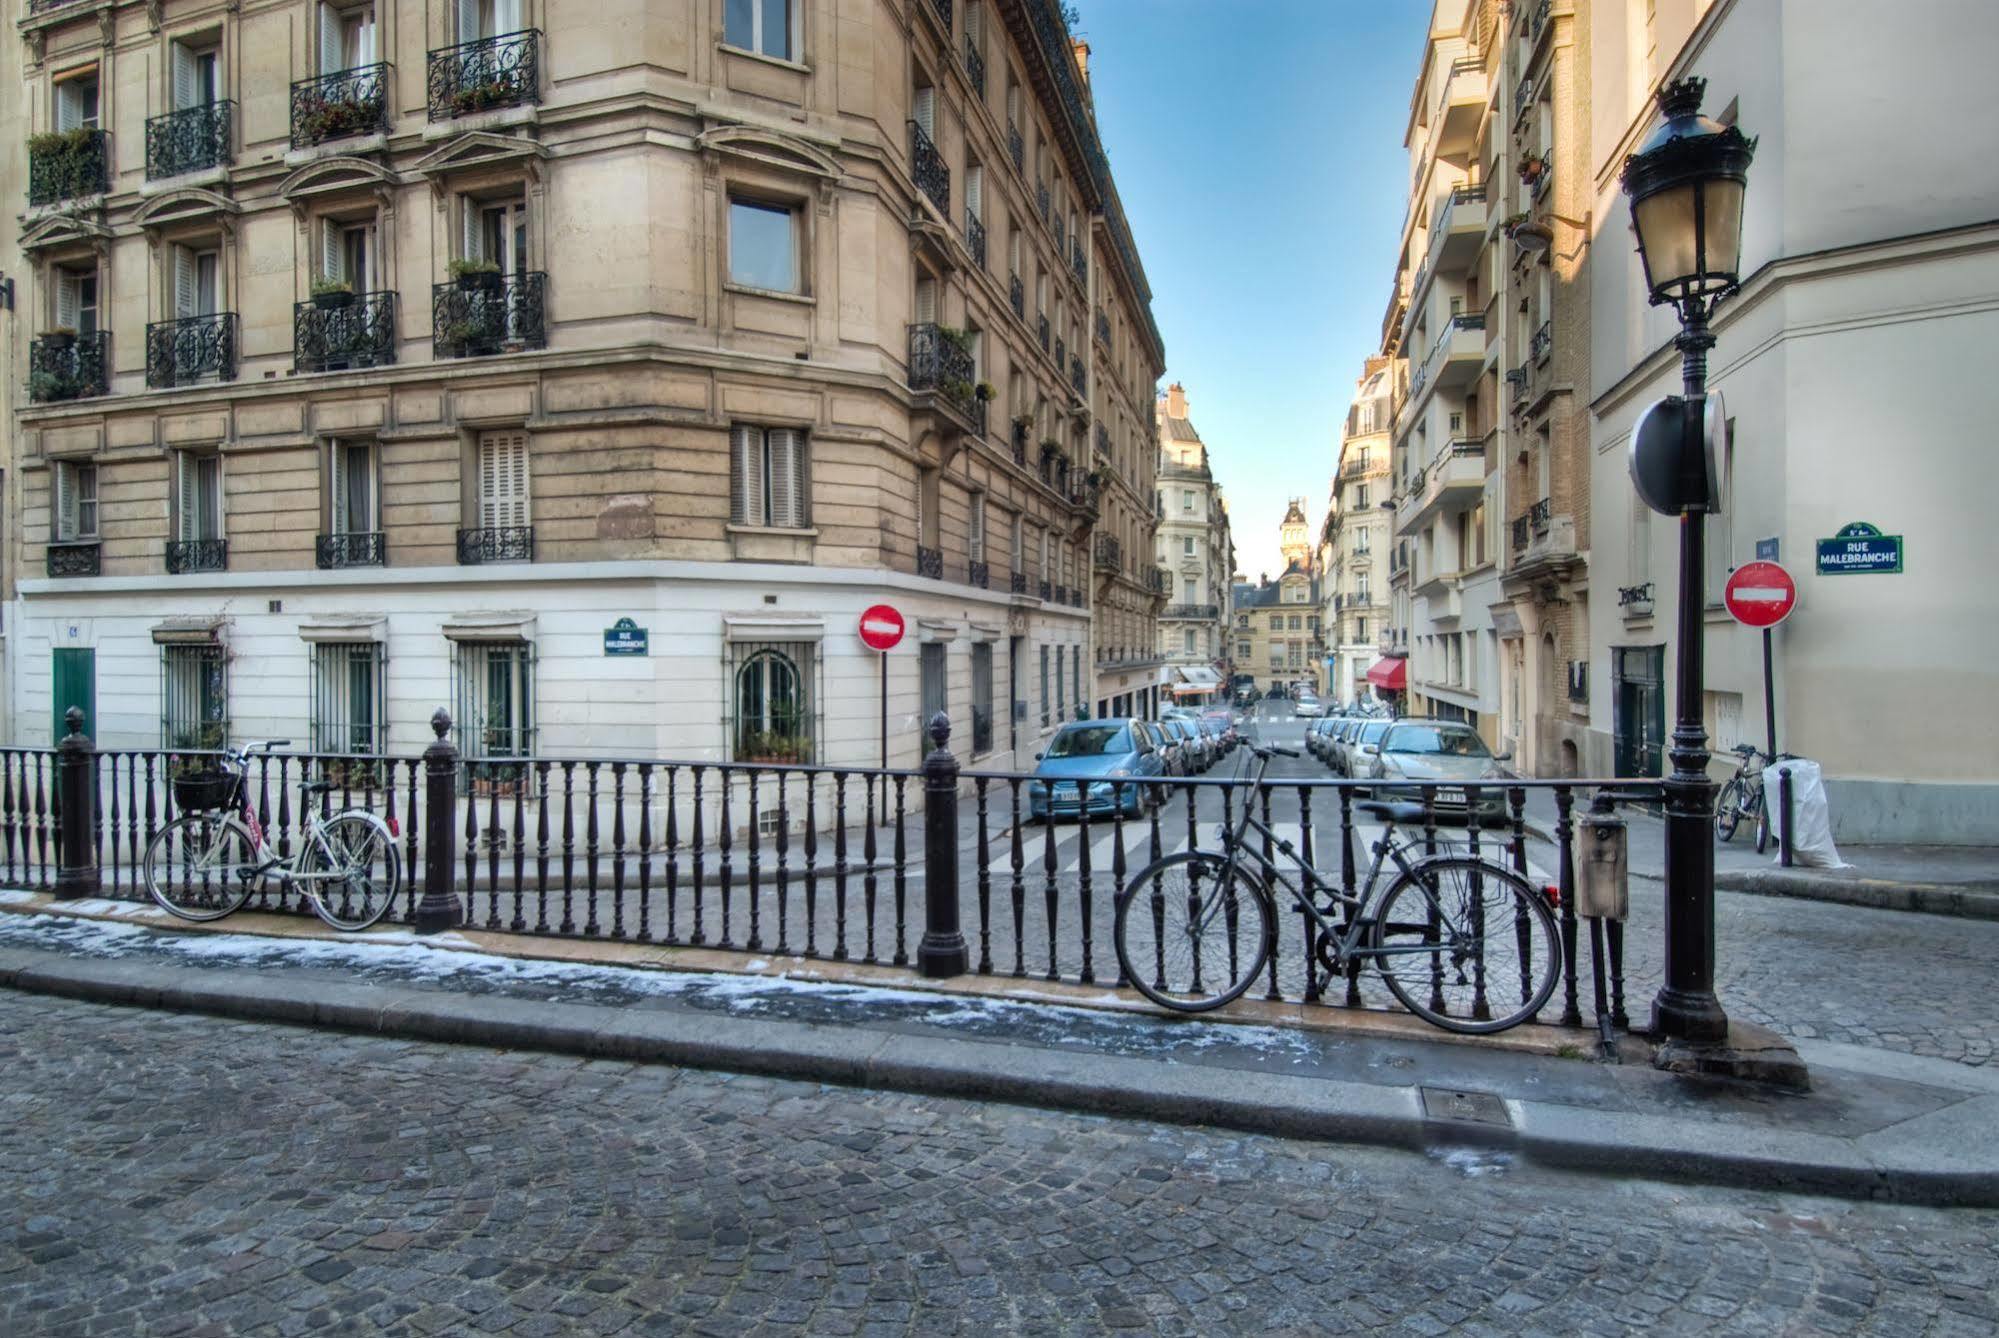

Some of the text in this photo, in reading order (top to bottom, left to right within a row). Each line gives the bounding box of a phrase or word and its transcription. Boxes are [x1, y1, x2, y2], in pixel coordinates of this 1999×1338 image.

[1847, 542, 1869, 552] RUE
[1820, 552, 1896, 564] MALEBRANCHE
[619, 632, 631, 640] RUE
